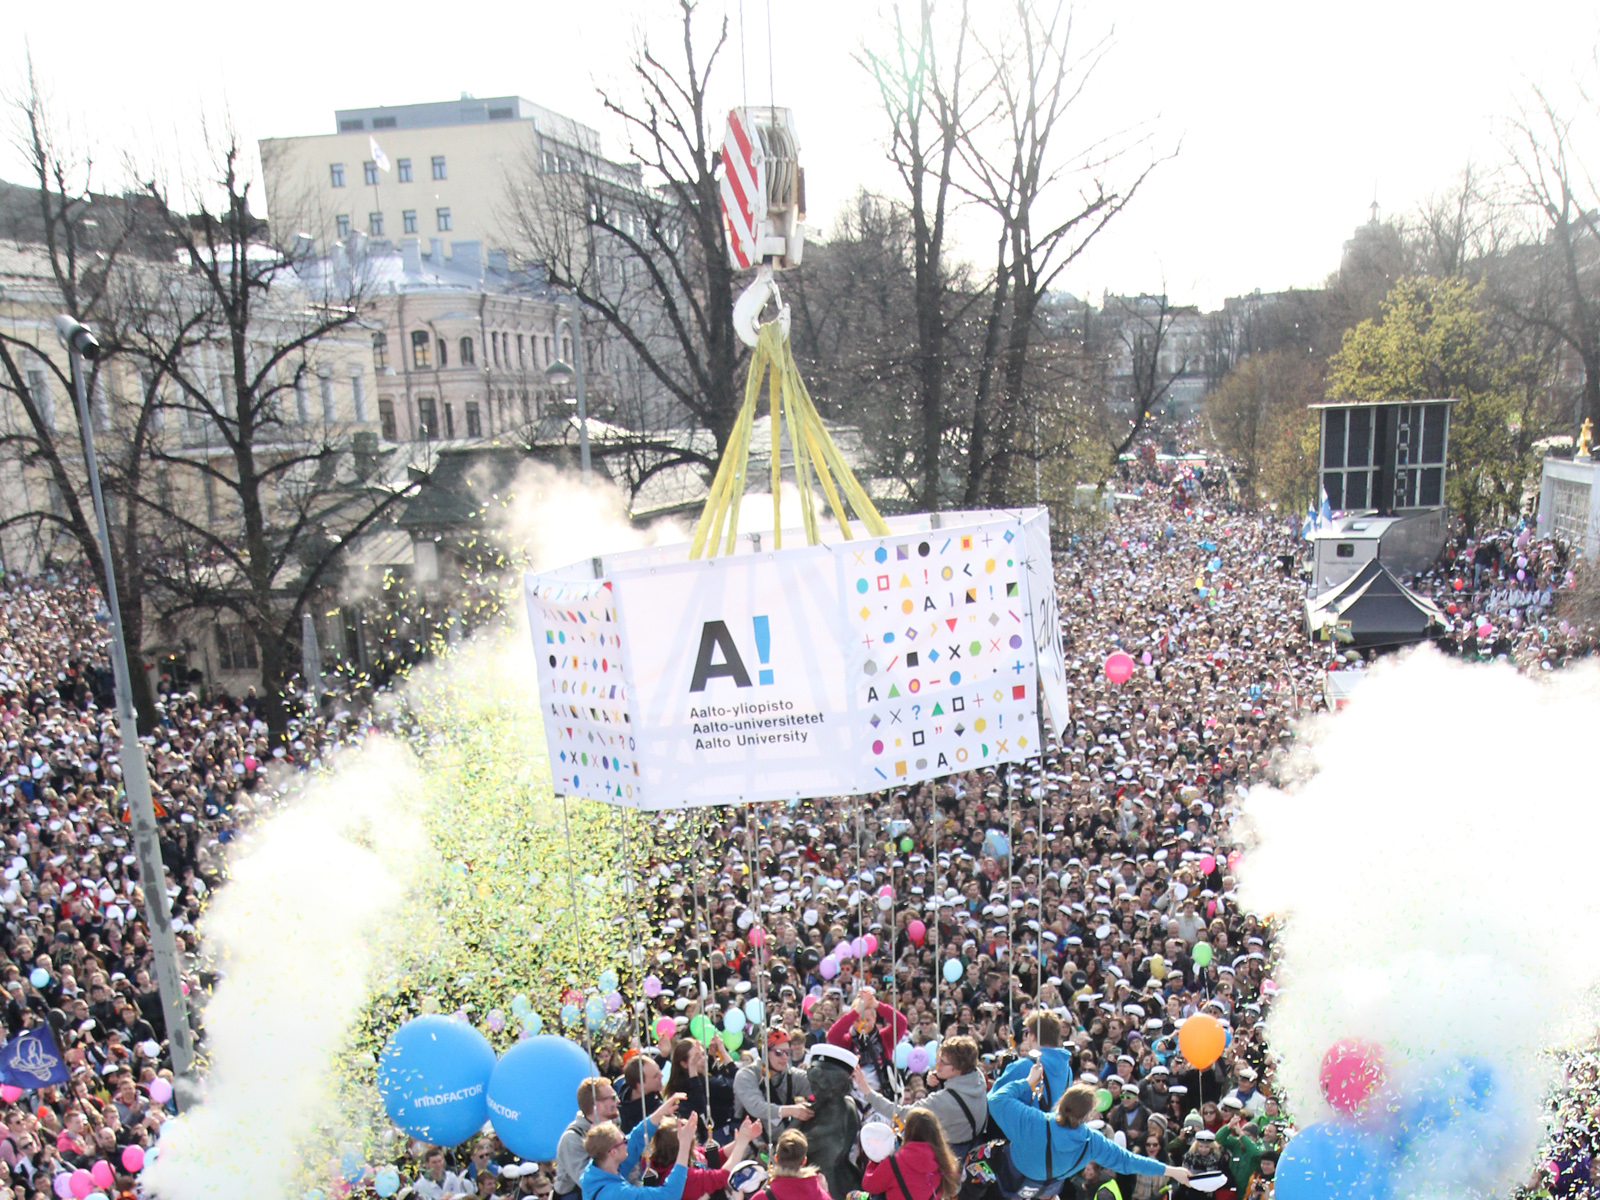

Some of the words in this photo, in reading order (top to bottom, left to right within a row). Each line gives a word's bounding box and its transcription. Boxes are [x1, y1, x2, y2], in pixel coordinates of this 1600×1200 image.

[689, 615, 774, 693] A!
[690, 700, 794, 719] Aalto-yliopisto
[693, 712, 825, 735] Aalto-universitetet
[695, 737, 732, 751] Aalto
[737, 730, 808, 747] University
